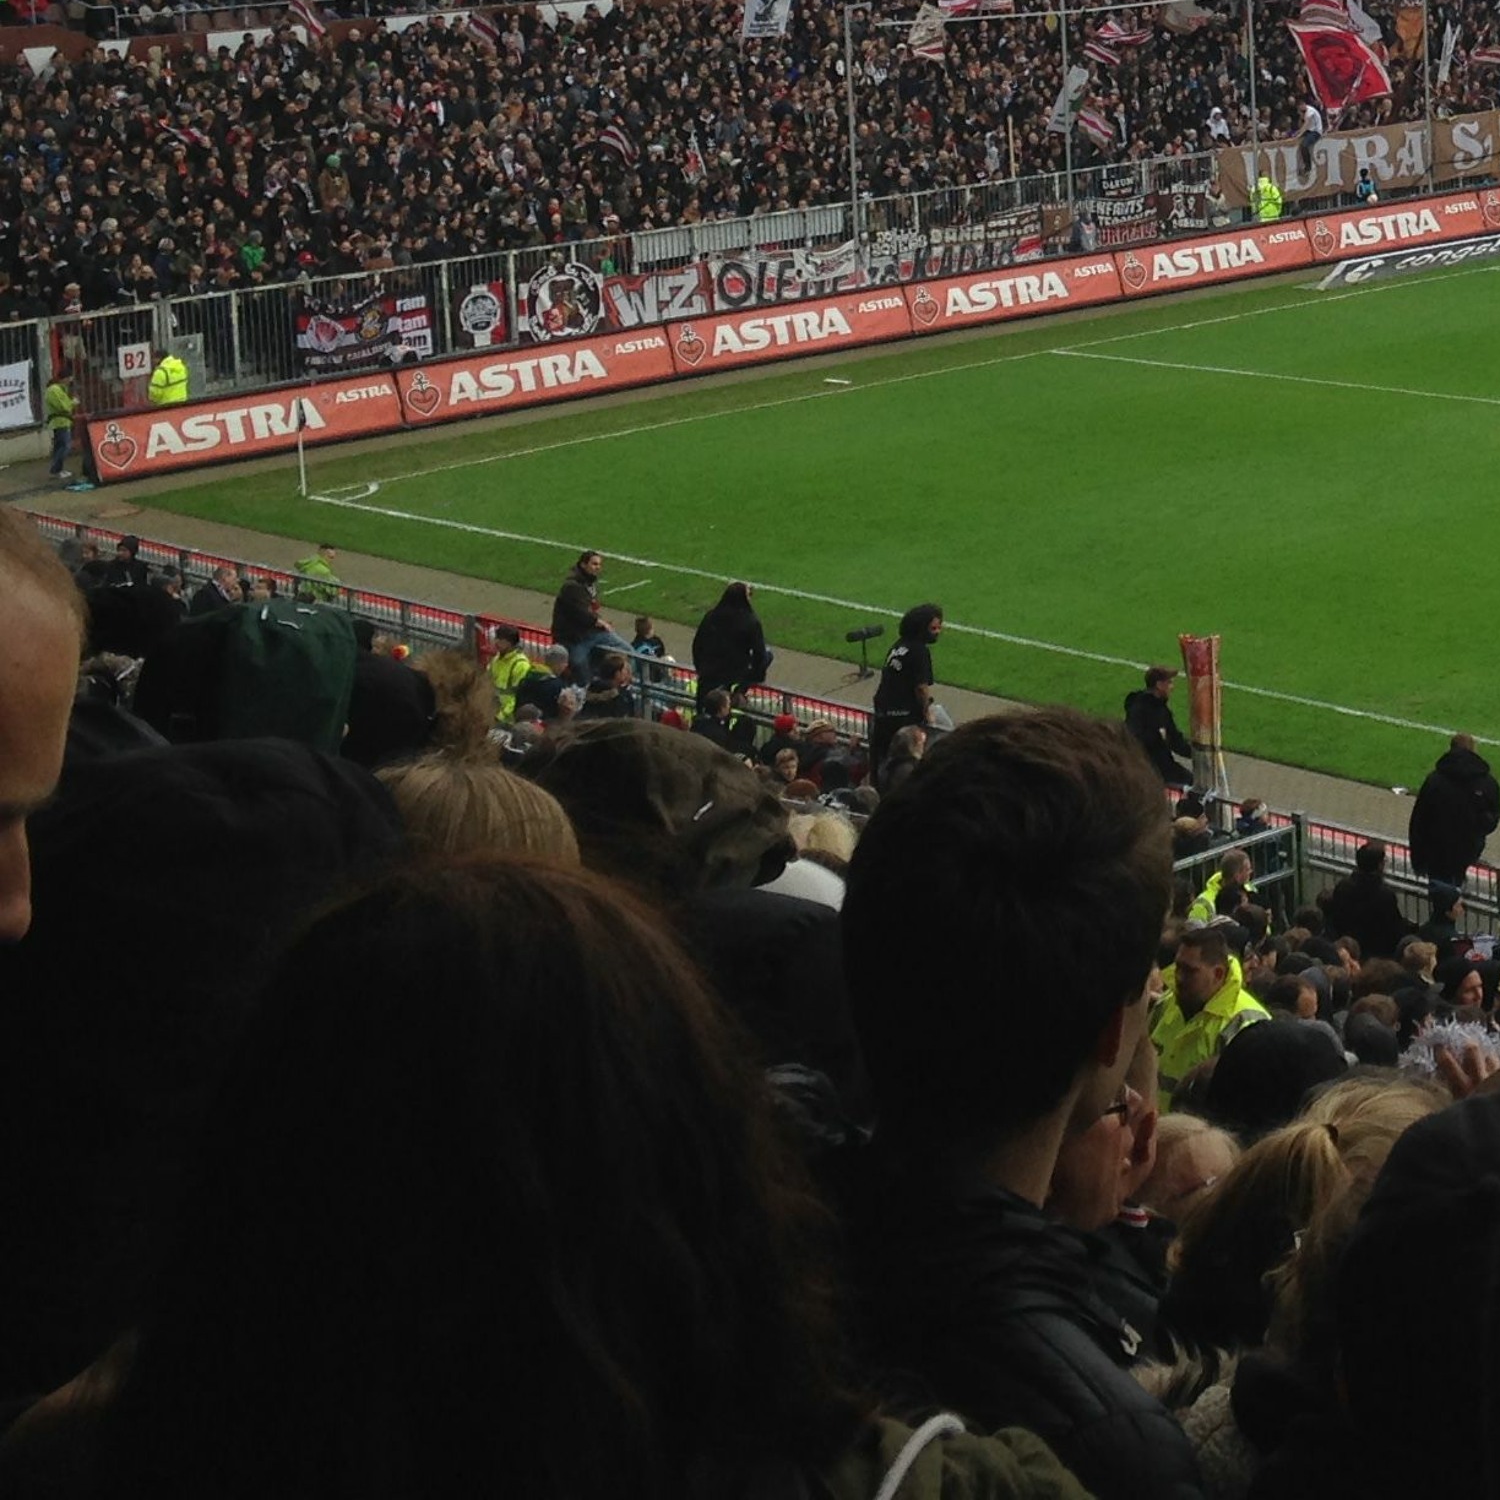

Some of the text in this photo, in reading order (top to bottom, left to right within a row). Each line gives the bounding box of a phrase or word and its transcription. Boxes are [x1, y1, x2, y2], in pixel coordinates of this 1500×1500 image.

[1339, 199, 1478, 249] ASTRA ASTRA
[1152, 229, 1305, 281] ASTRA ASTRA
[946, 262, 1114, 317] ASTRA ASTRA
[712, 297, 904, 357] ASTRA ASTRA
[123, 351, 146, 371] B2
[448, 336, 666, 407] ASTRA ASTRA
[145, 384, 393, 460] ASTRA ASTRA
